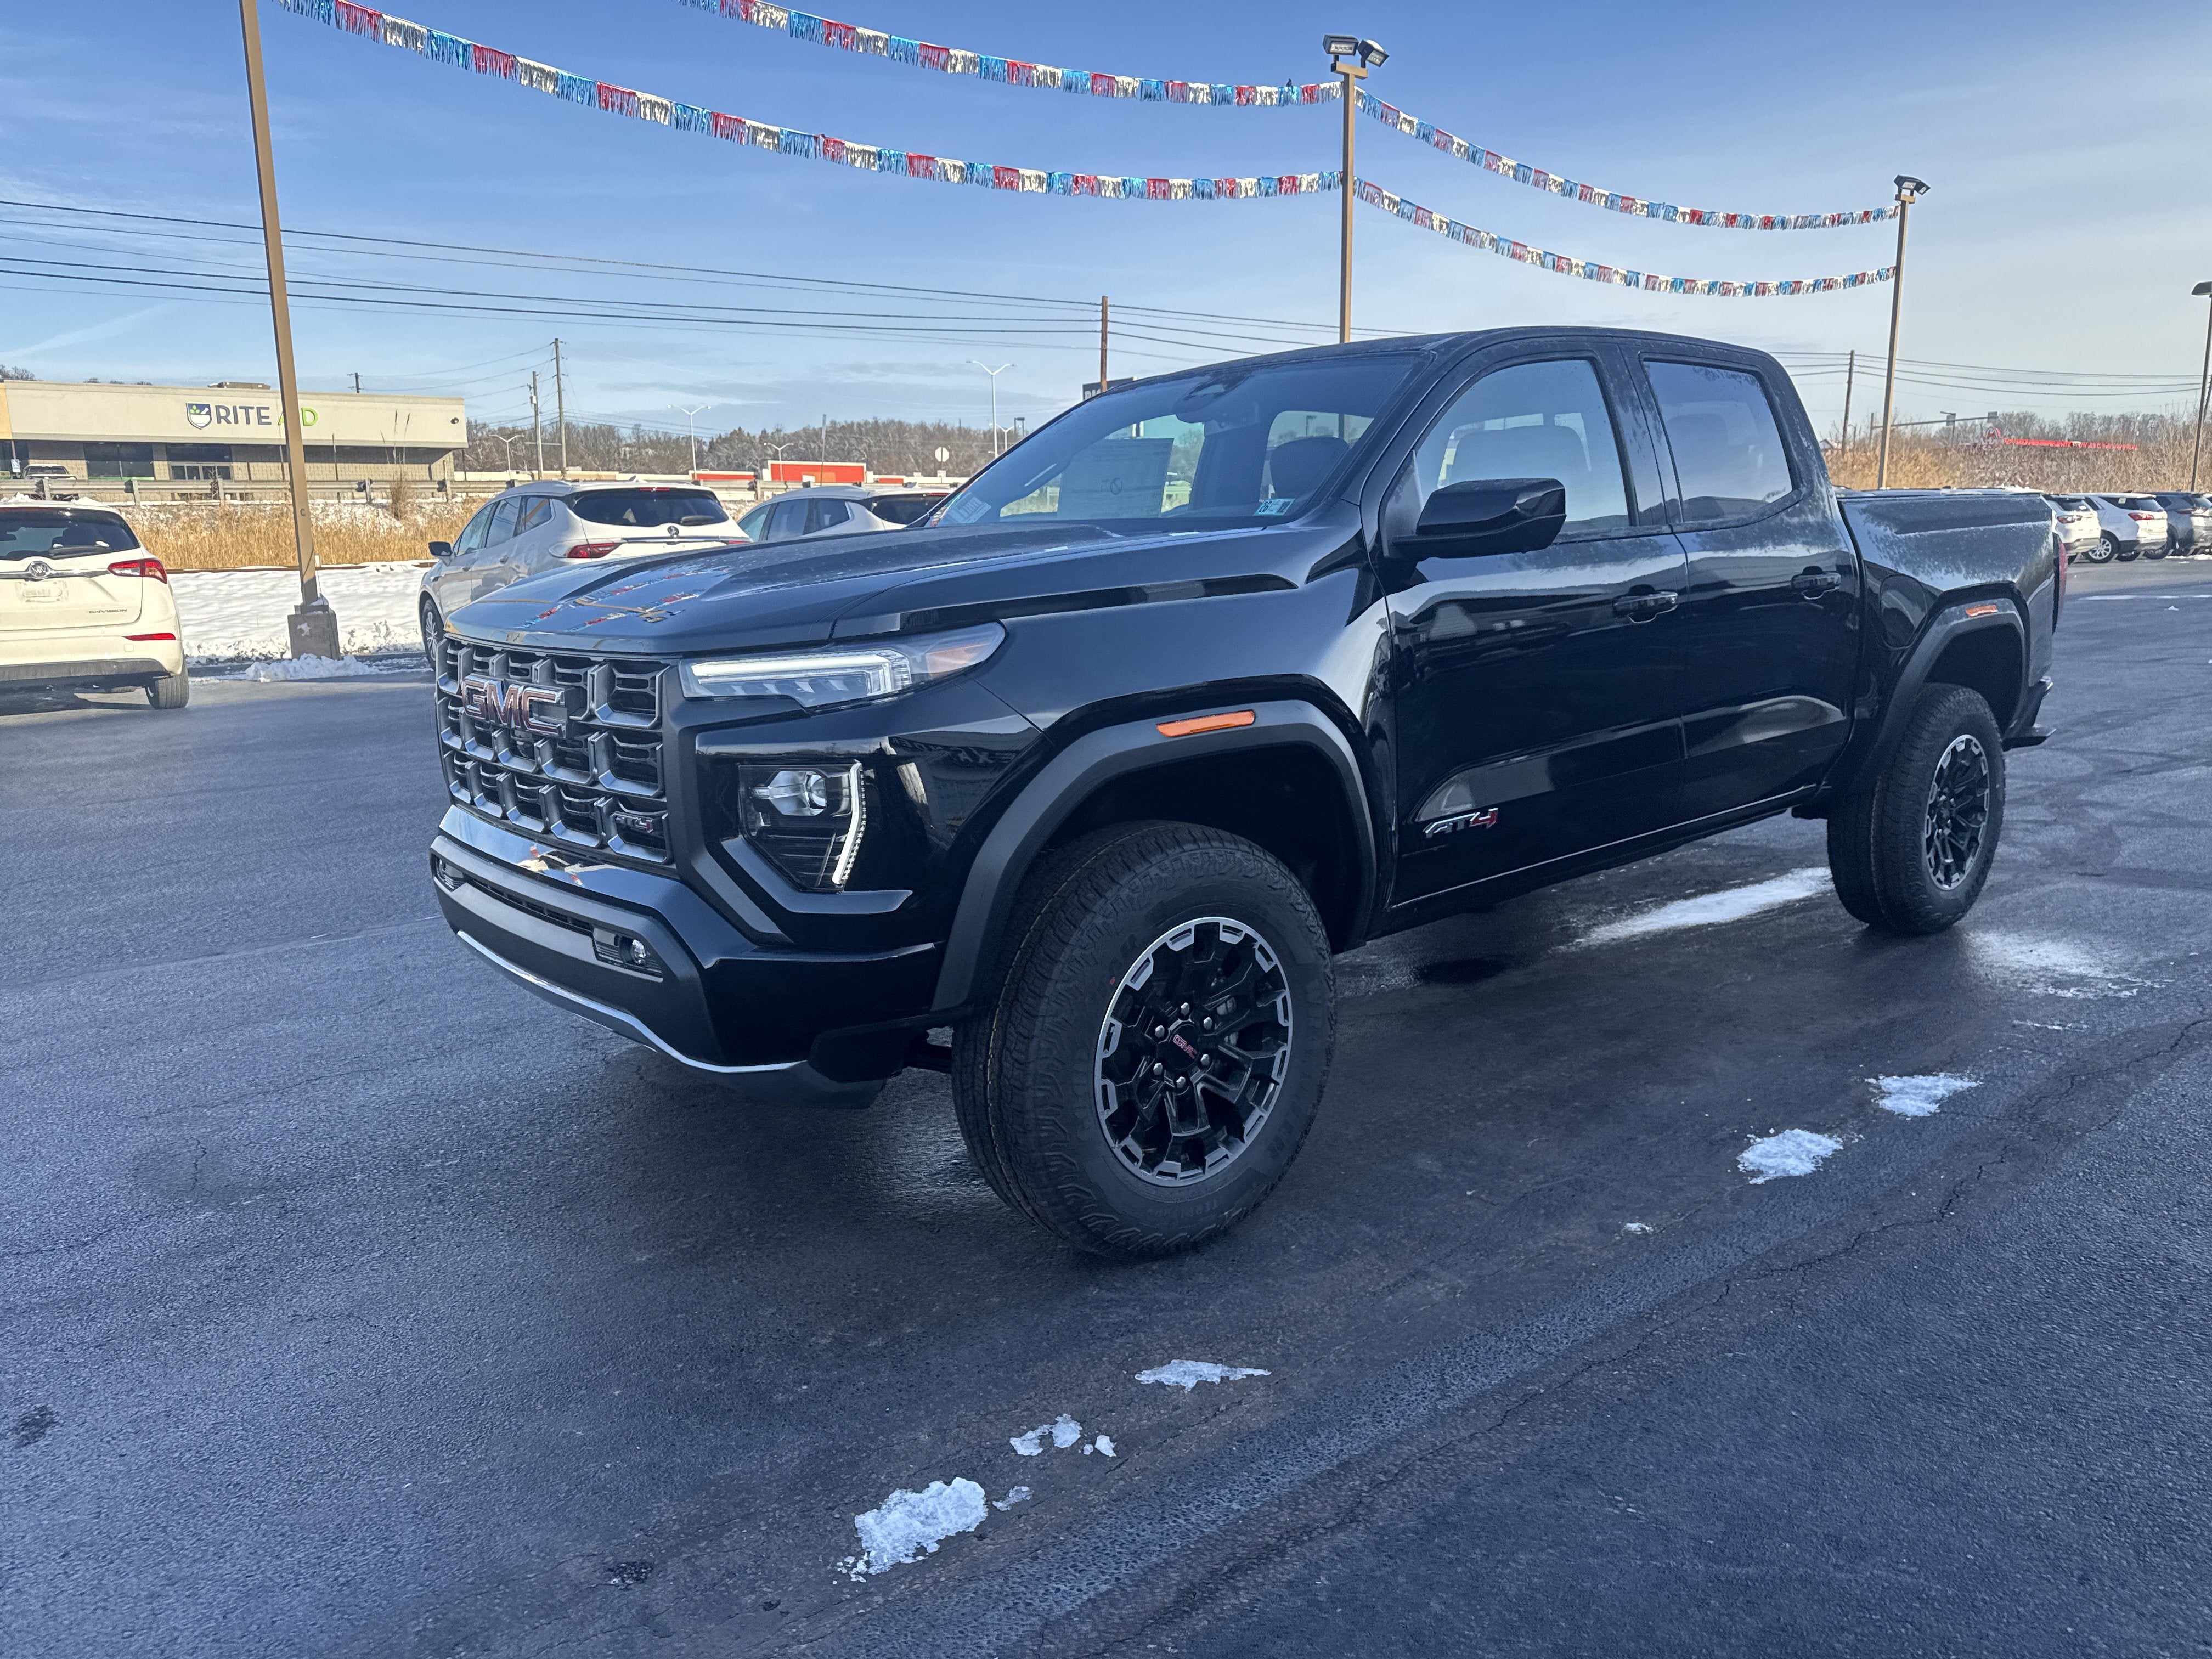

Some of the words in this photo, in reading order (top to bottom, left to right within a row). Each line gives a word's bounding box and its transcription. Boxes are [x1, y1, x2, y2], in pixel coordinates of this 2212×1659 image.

[215, 405, 272, 425] RITE
[462, 675, 566, 739] GMC
[1422, 807, 1498, 839] AT4
[1172, 1034, 1198, 1059] GMC
